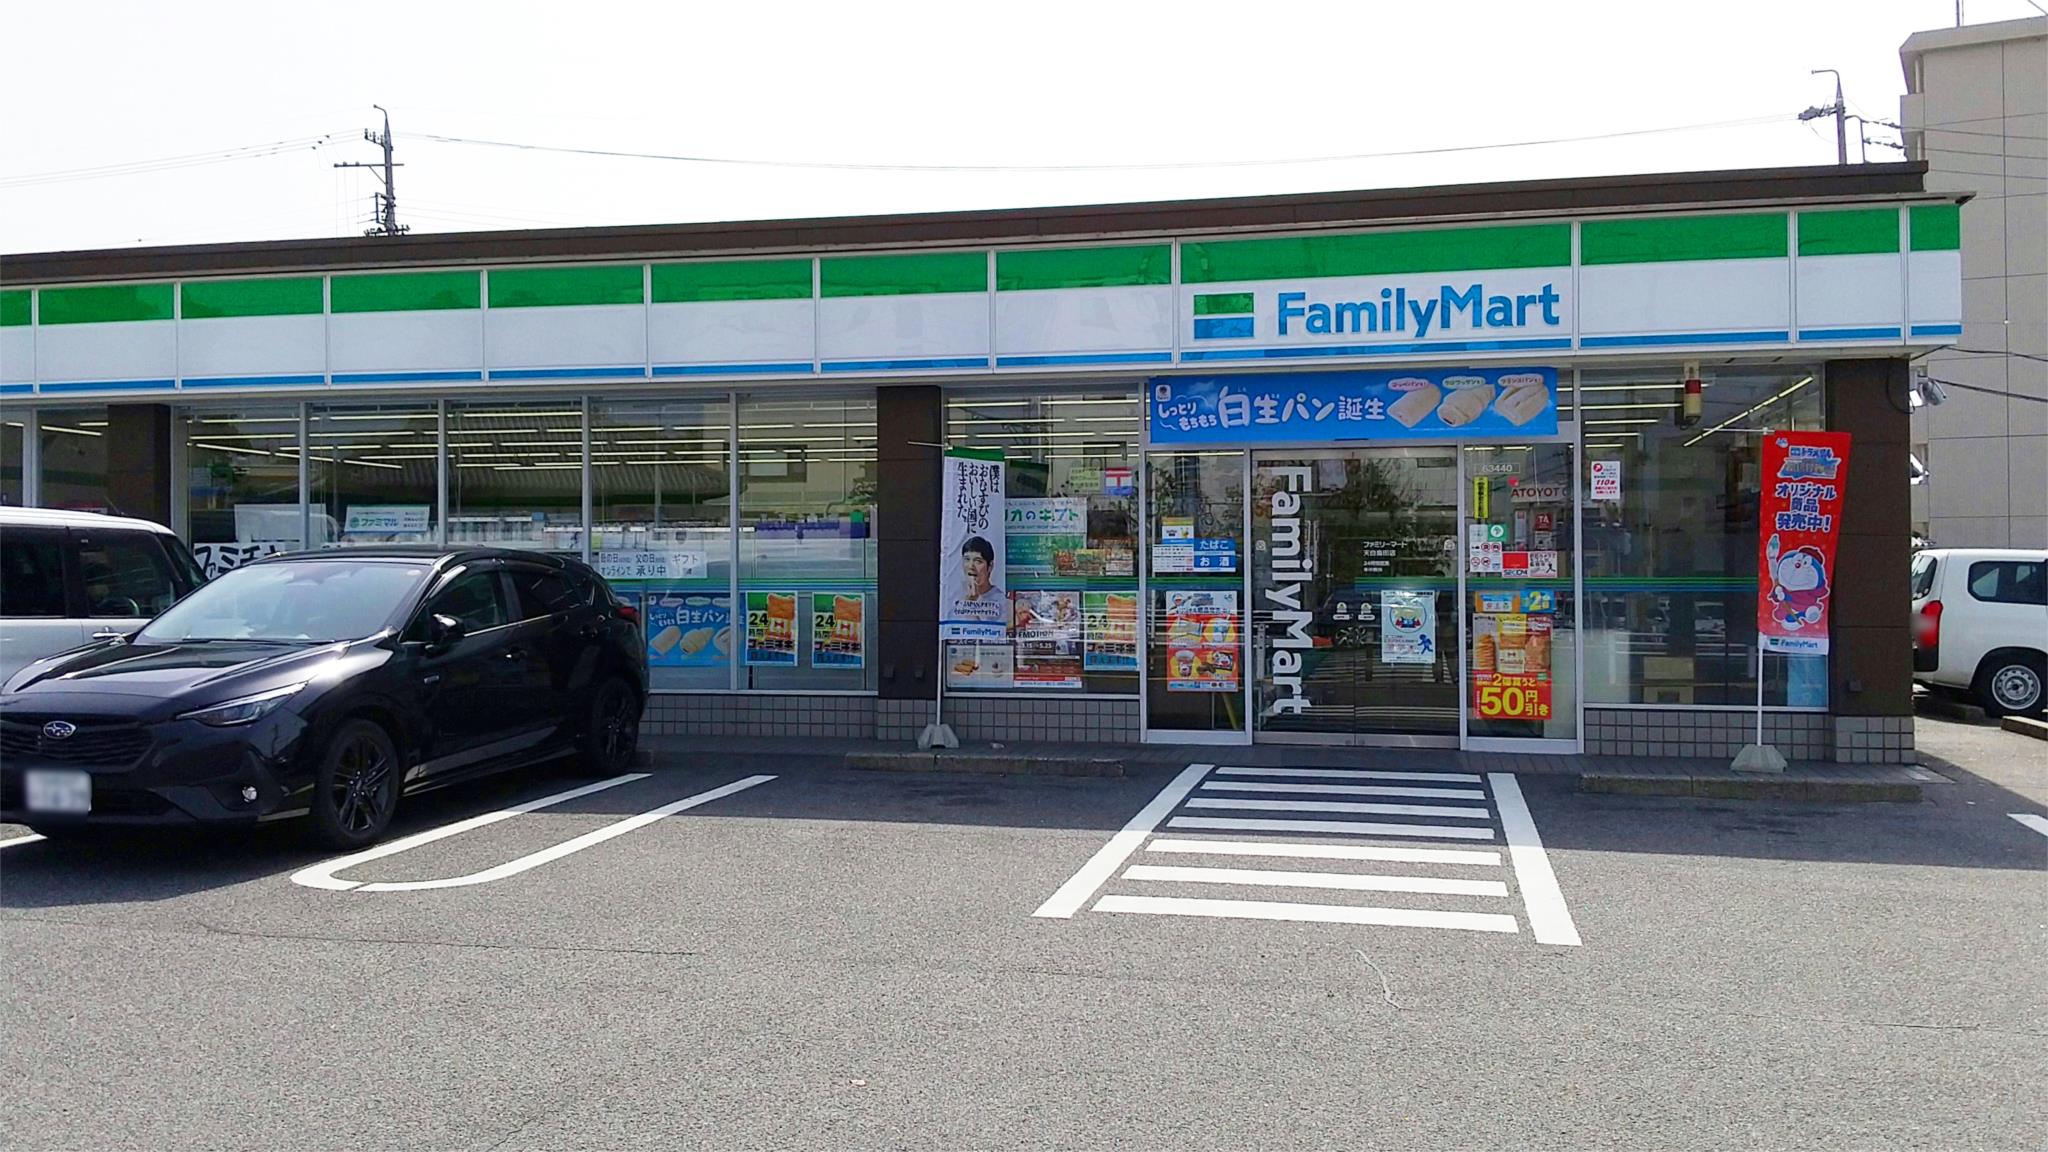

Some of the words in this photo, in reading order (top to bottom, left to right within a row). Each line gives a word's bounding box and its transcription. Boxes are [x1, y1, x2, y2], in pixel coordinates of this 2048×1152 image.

[1278, 283, 1559, 337] FamilyMart
[1158, 402, 1197, 418] しっとり
[1179, 415, 1217, 431] もちもち
[990, 465, 1000, 493] 僕は
[978, 464, 989, 530] おむすびの
[1776, 483, 1836, 499] オリジナル
[967, 464, 977, 534] おいしい国に
[1791, 498, 1818, 513] 商品
[361, 517, 398, 528] ファミマル
[1777, 513, 1831, 531] 発売中!
[1200, 541, 1229, 550] たばこ
[1363, 541, 1408, 549] ファミリーマート
[636, 553, 655, 564] 父の日
[672, 554, 699, 565] ギフト
[637, 566, 666, 577] 承り中
[1265, 466, 1313, 714] FamilyMart
[749, 613, 768, 625] 24
[815, 615, 835, 627] 24
[1087, 615, 1108, 628] 24
[963, 627, 1000, 637] FamilyMart
[1780, 638, 1818, 649] FamilyMart
